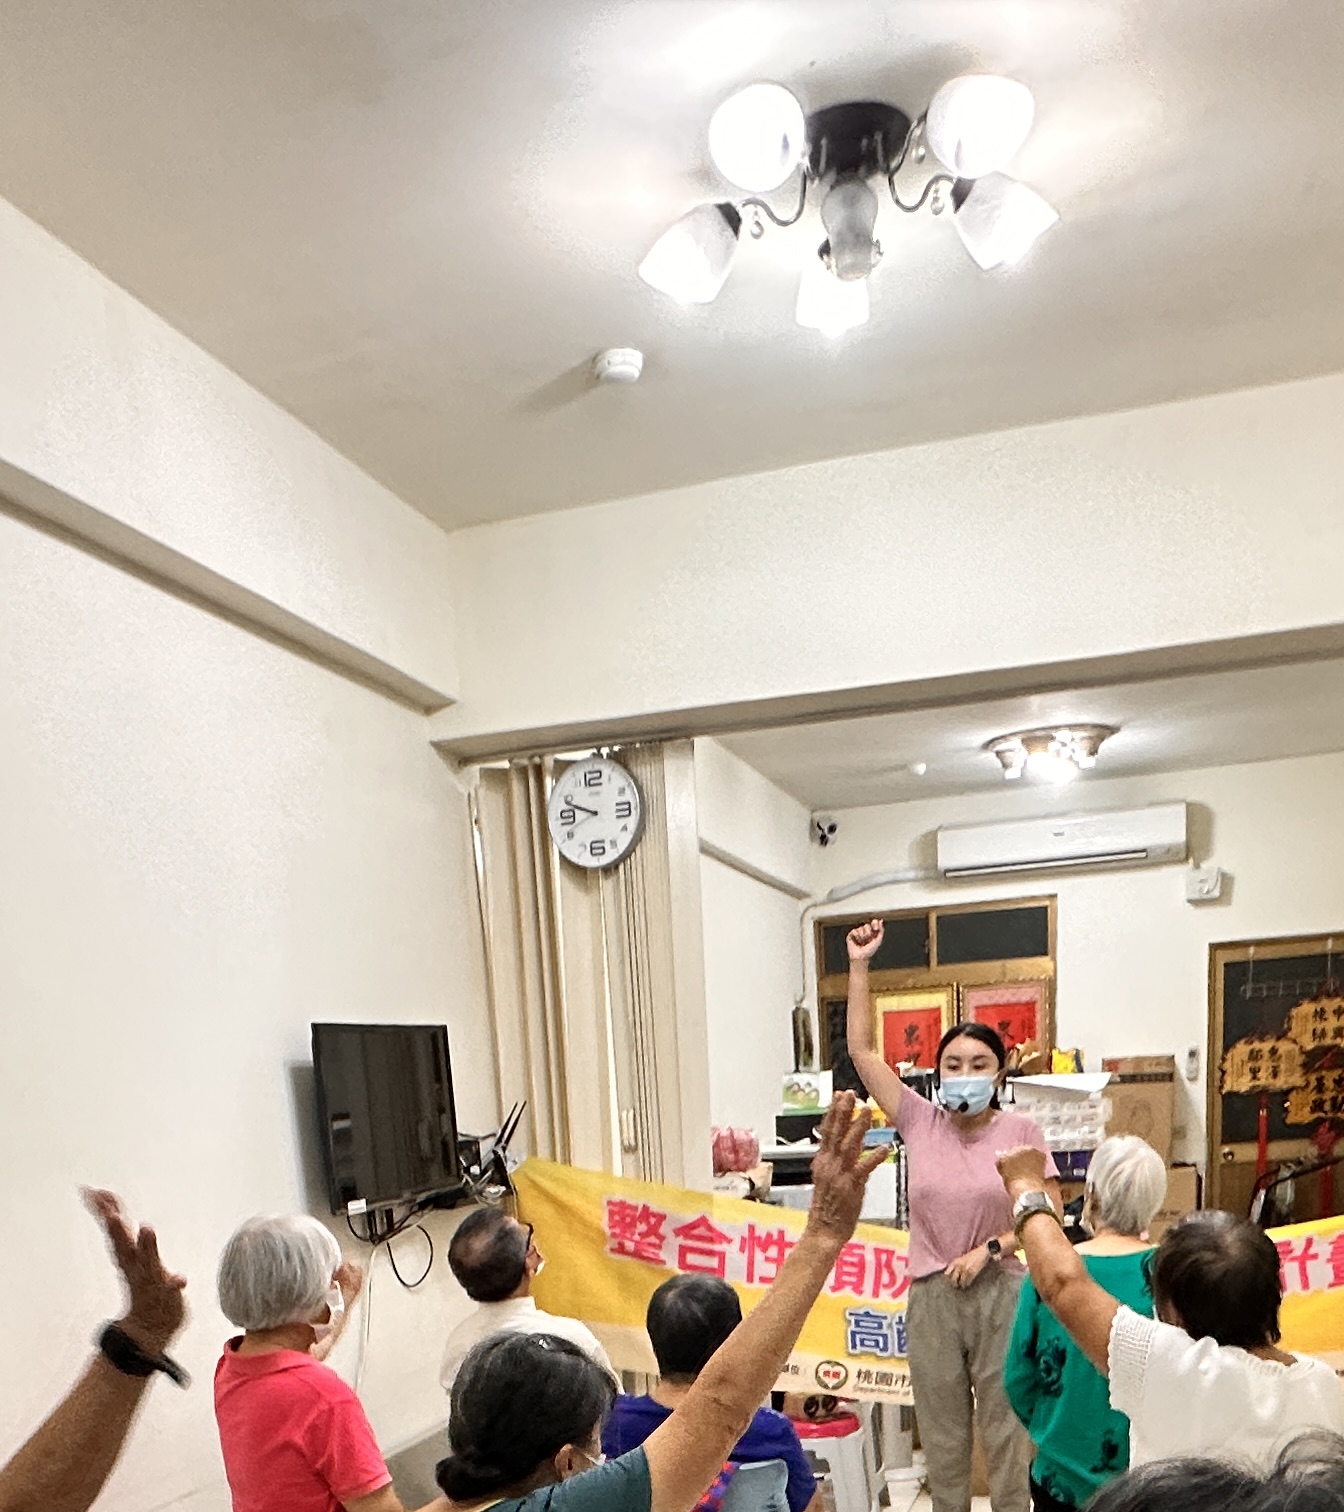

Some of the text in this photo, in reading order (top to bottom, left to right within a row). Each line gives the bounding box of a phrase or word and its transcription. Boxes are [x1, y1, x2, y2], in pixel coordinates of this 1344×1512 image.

[584, 769, 603, 787] 12
[560, 808, 576, 826] 9
[615, 801, 631, 819] 3
[589, 839, 606, 858] 6
[848, 1310, 906, 1354] 高
